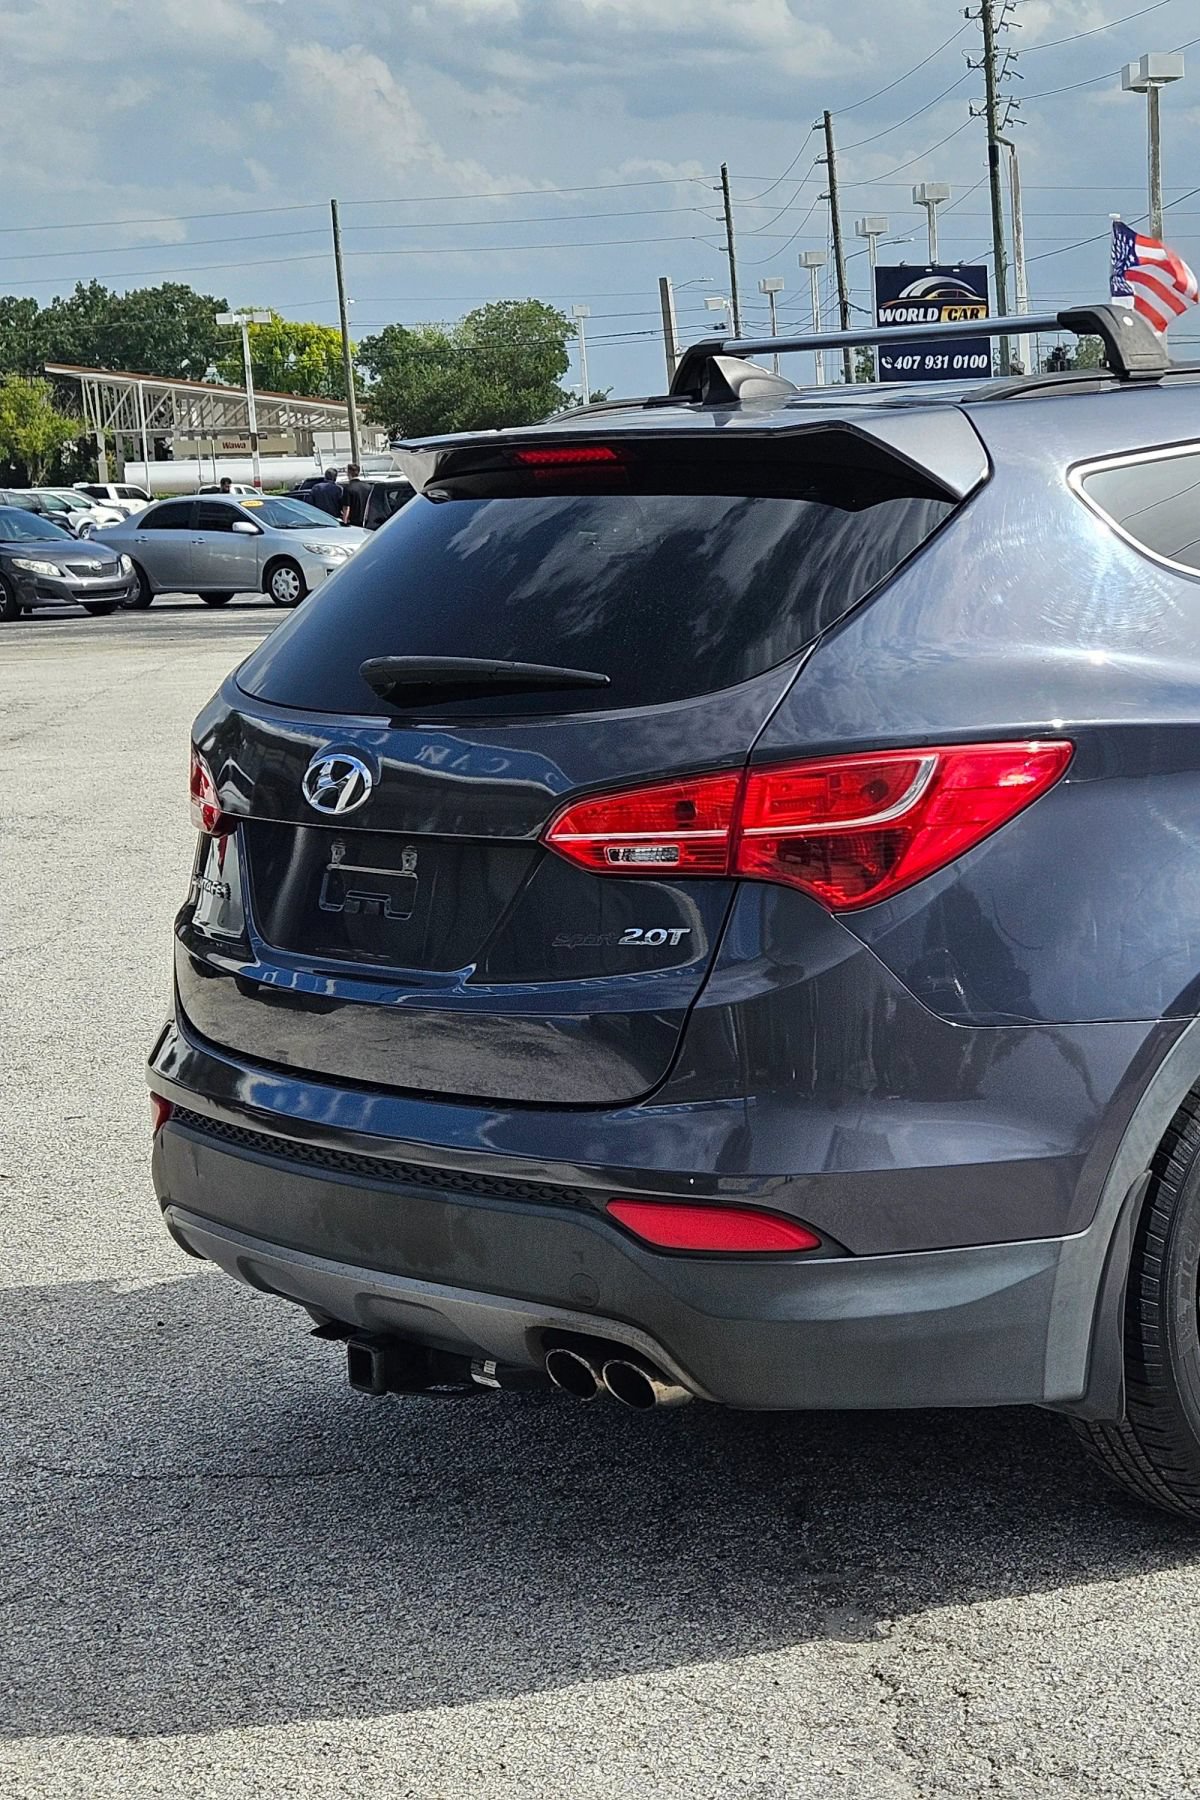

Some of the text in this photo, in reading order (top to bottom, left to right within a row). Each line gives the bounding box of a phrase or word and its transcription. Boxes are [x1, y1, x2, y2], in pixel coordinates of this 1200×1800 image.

[878, 307, 980, 322] WORLD CAR
[893, 354, 988, 370] 407 931 0100
